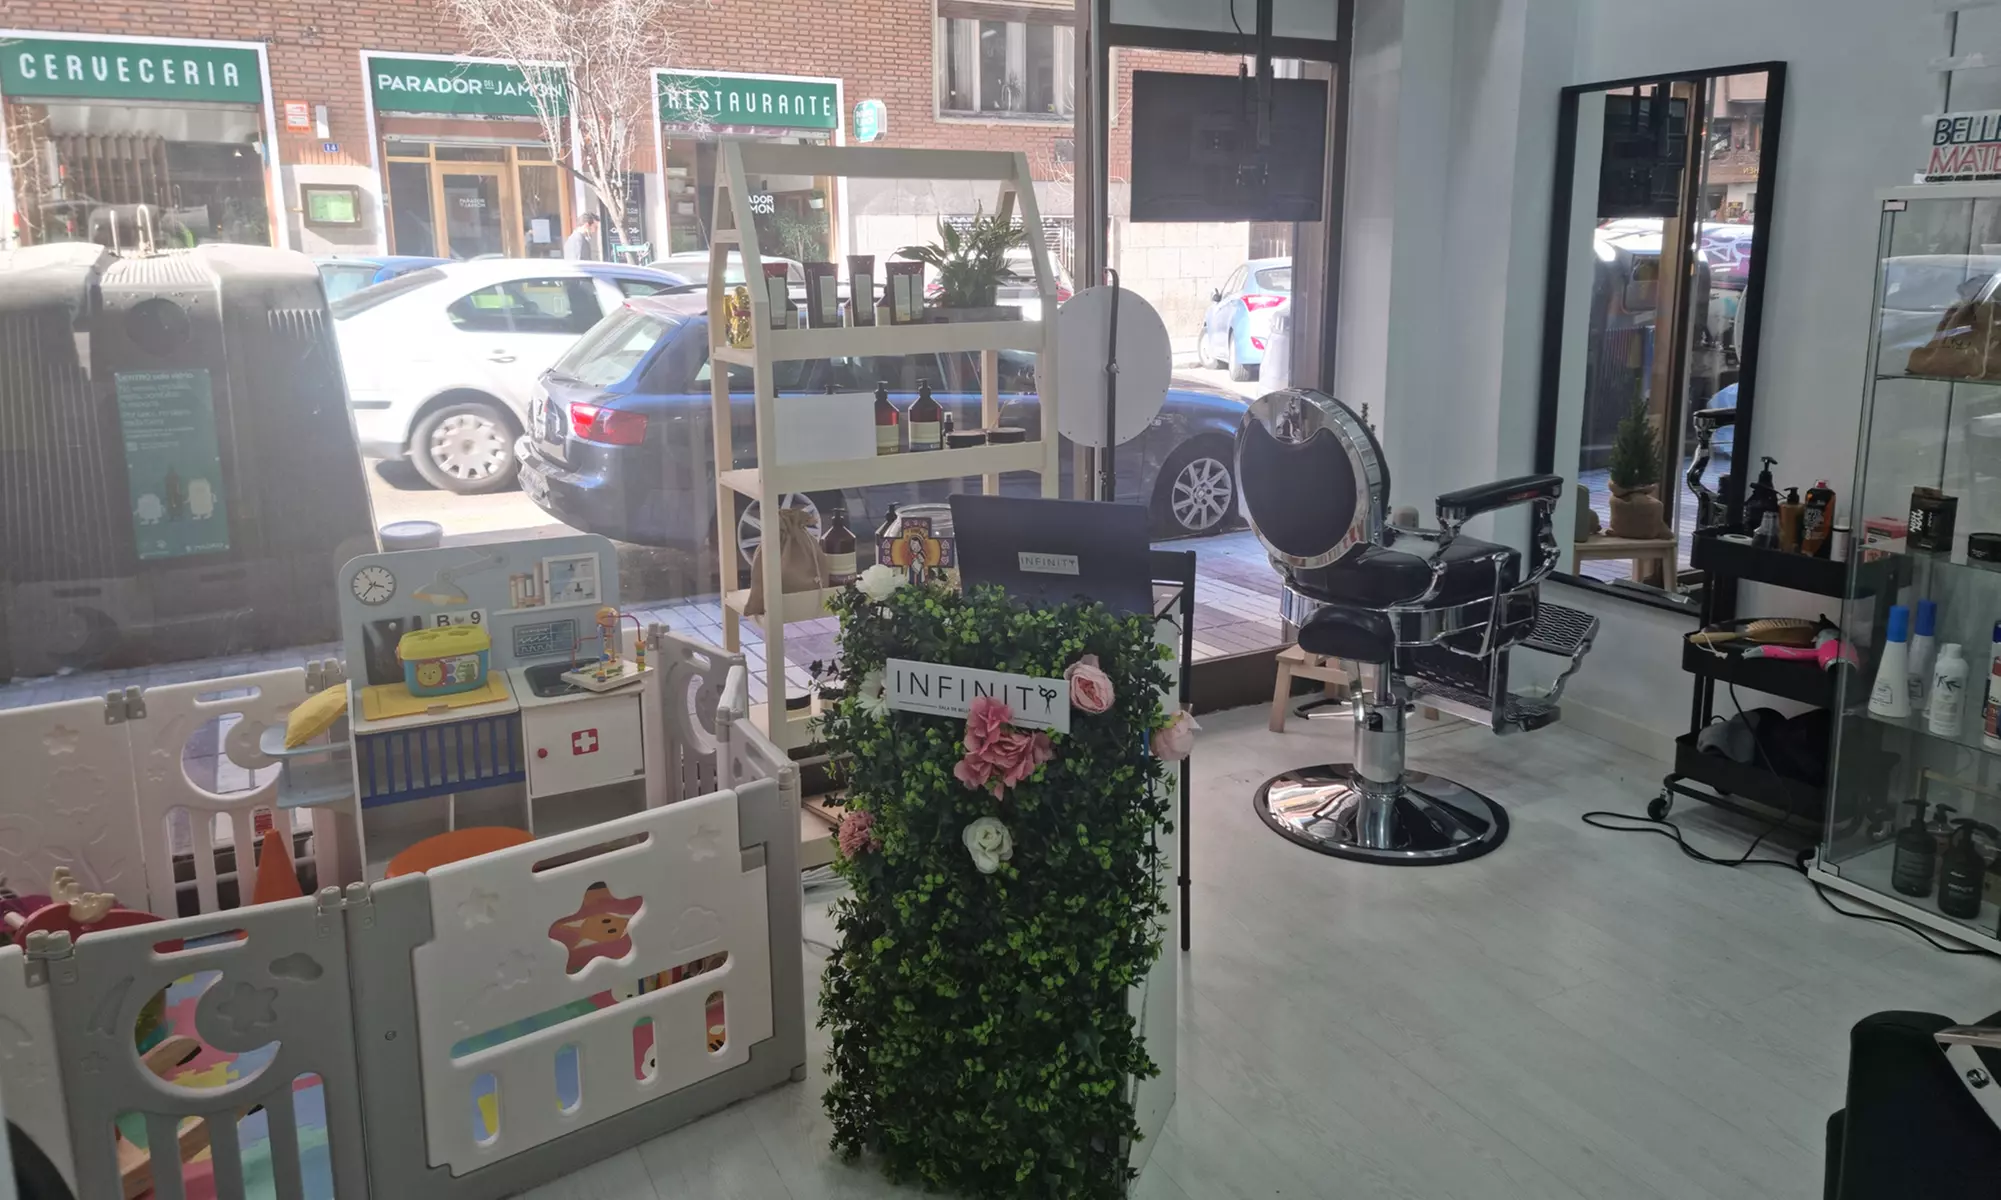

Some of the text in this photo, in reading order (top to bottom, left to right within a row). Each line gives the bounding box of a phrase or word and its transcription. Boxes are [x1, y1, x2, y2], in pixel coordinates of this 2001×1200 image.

[19, 53, 239, 87] CERVECERIA
[378, 74, 483, 95] PARADOR
[668, 90, 831, 116] RESTAURANTE
[1933, 115, 2001, 146] BELL
[470, 611, 481, 624] 9
